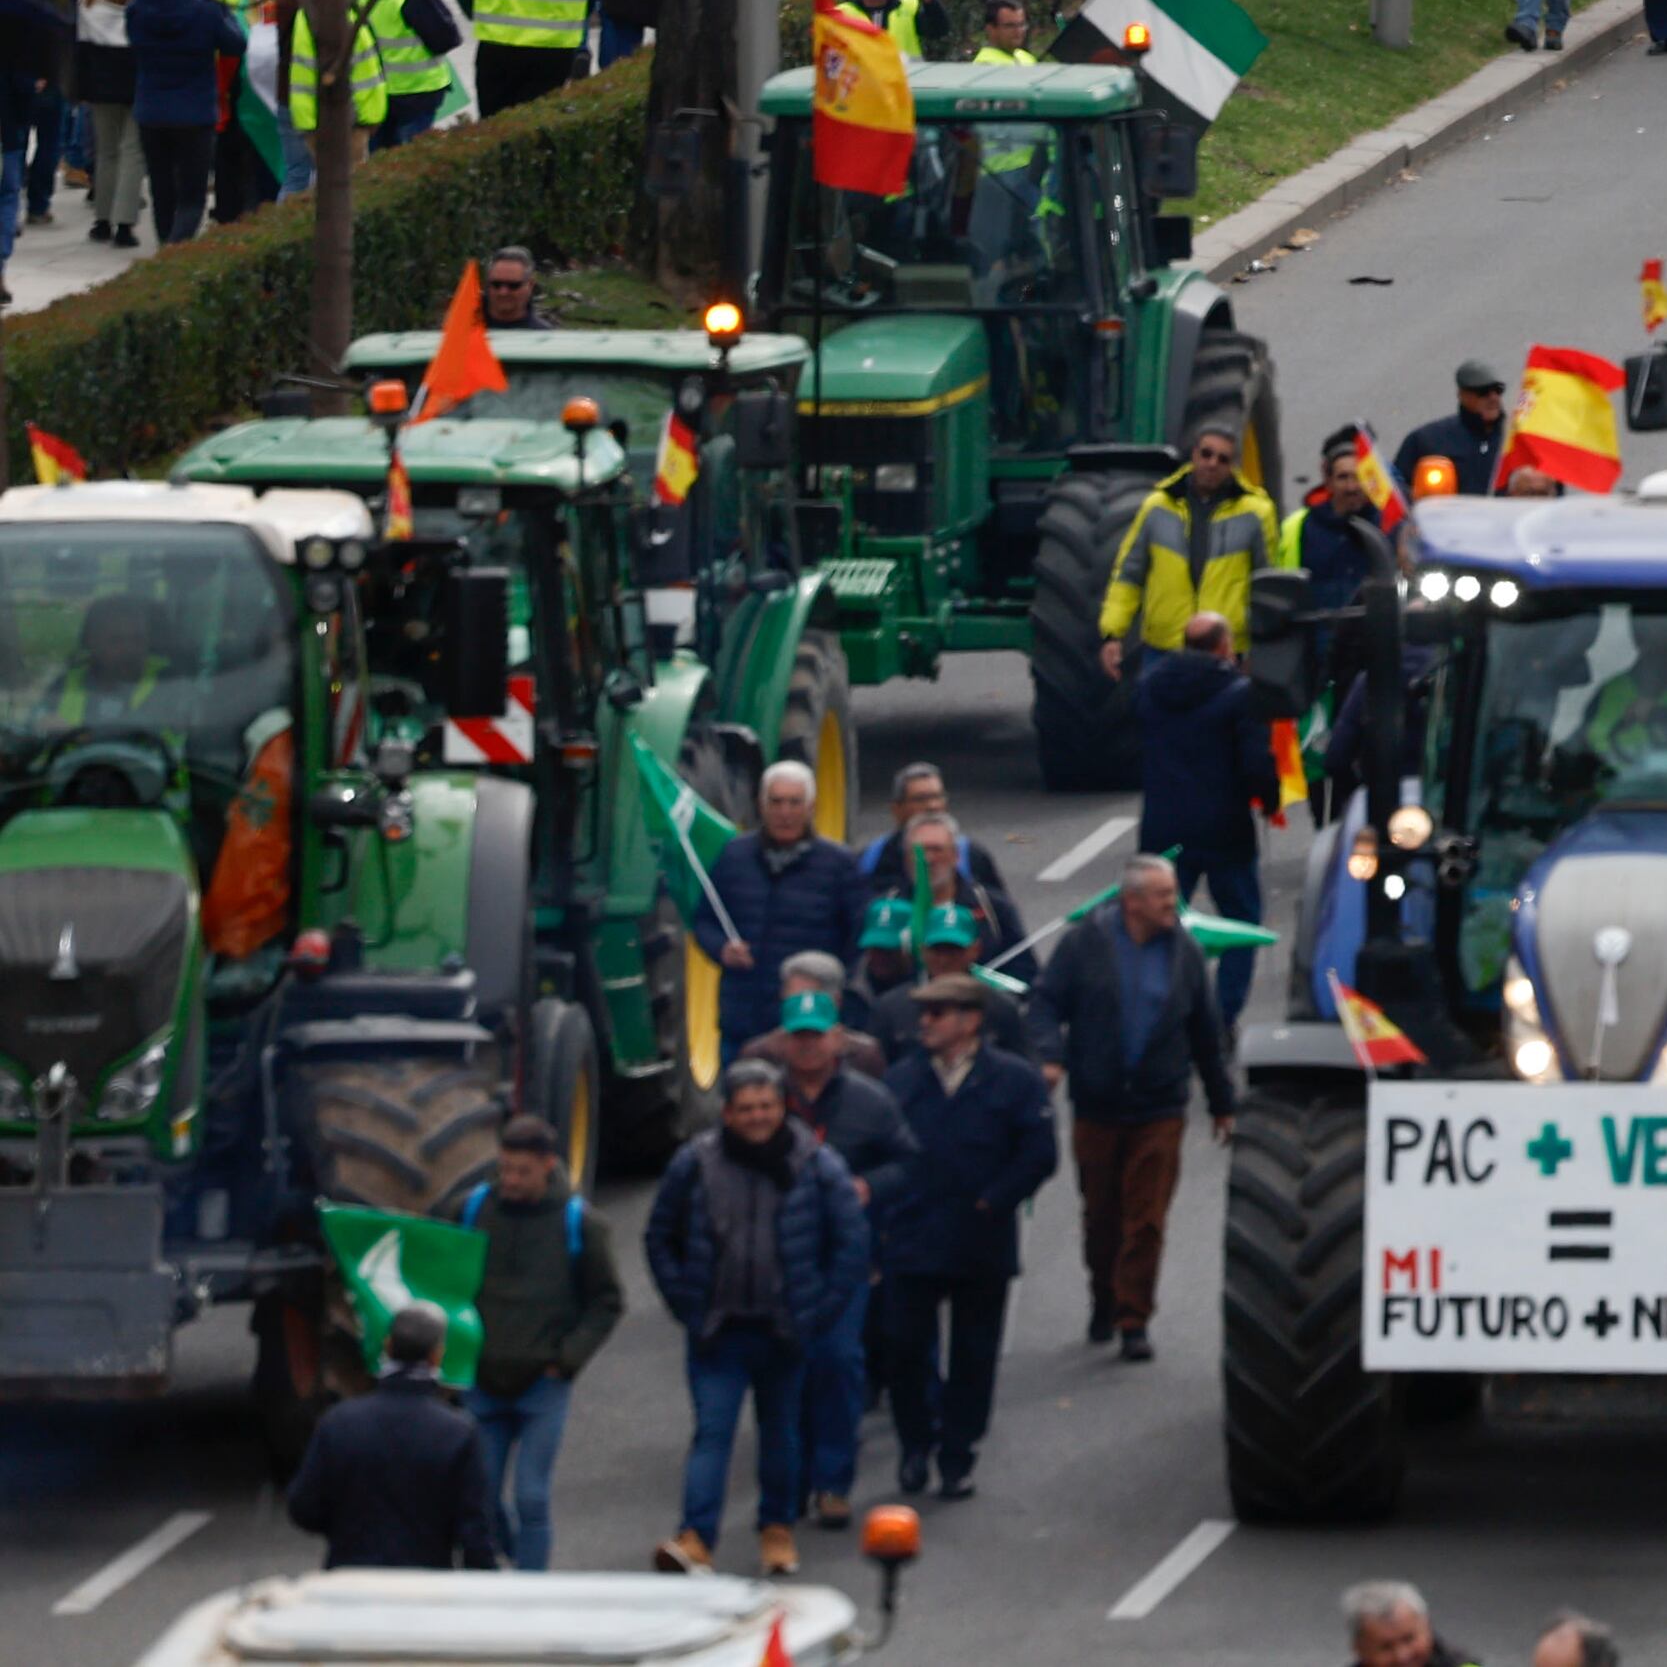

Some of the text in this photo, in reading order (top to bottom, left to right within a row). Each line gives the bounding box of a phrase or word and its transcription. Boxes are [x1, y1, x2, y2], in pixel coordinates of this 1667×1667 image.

[1384, 1117, 1497, 1185] PAC
[1382, 1246, 1443, 1293] MI
[1381, 1295, 1569, 1338] FUTURO
